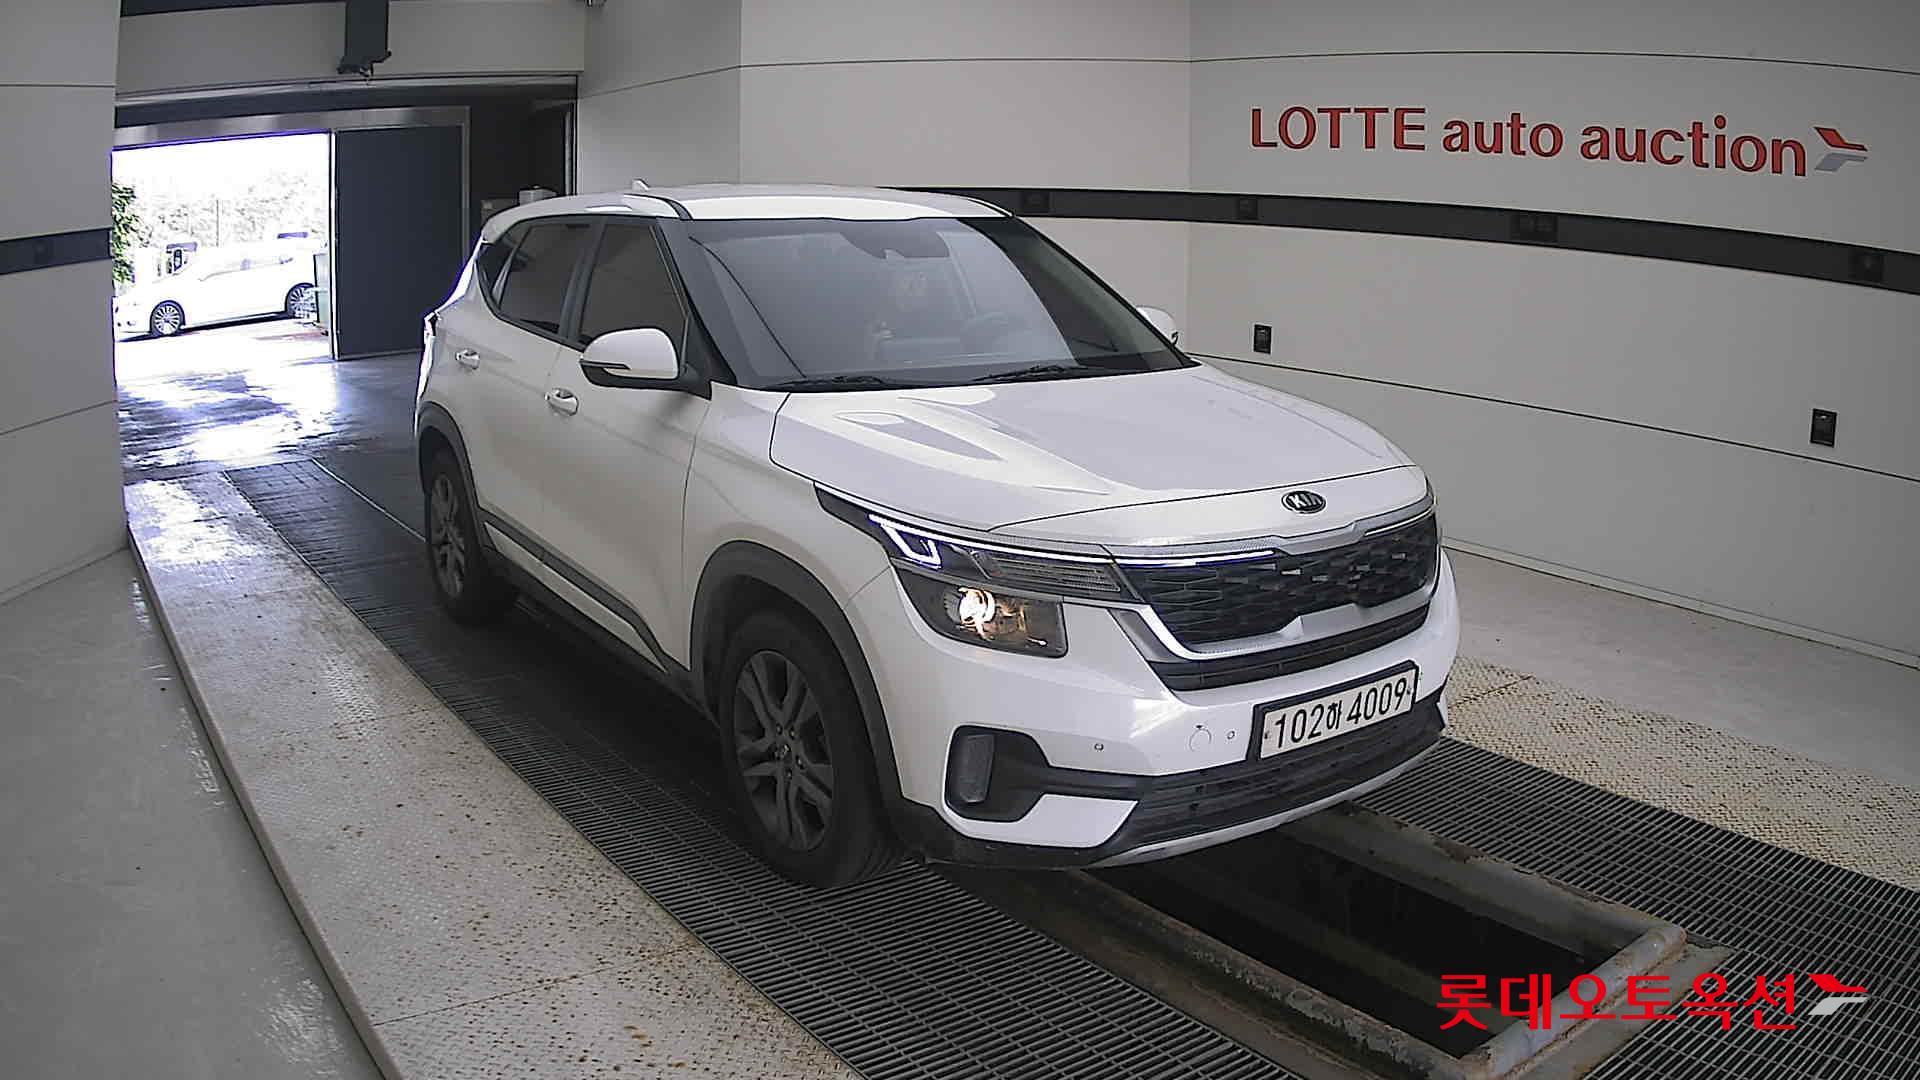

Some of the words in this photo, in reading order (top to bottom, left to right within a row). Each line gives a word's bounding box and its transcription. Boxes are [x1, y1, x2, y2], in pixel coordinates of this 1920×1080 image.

[1251, 106, 1426, 151] LOTTE
[1442, 112, 1564, 158] auto
[1580, 114, 1807, 177] auction
[1288, 493, 1322, 509] KIA
[1274, 700, 1343, 749] 102하
[1346, 677, 1408, 725] 4009
